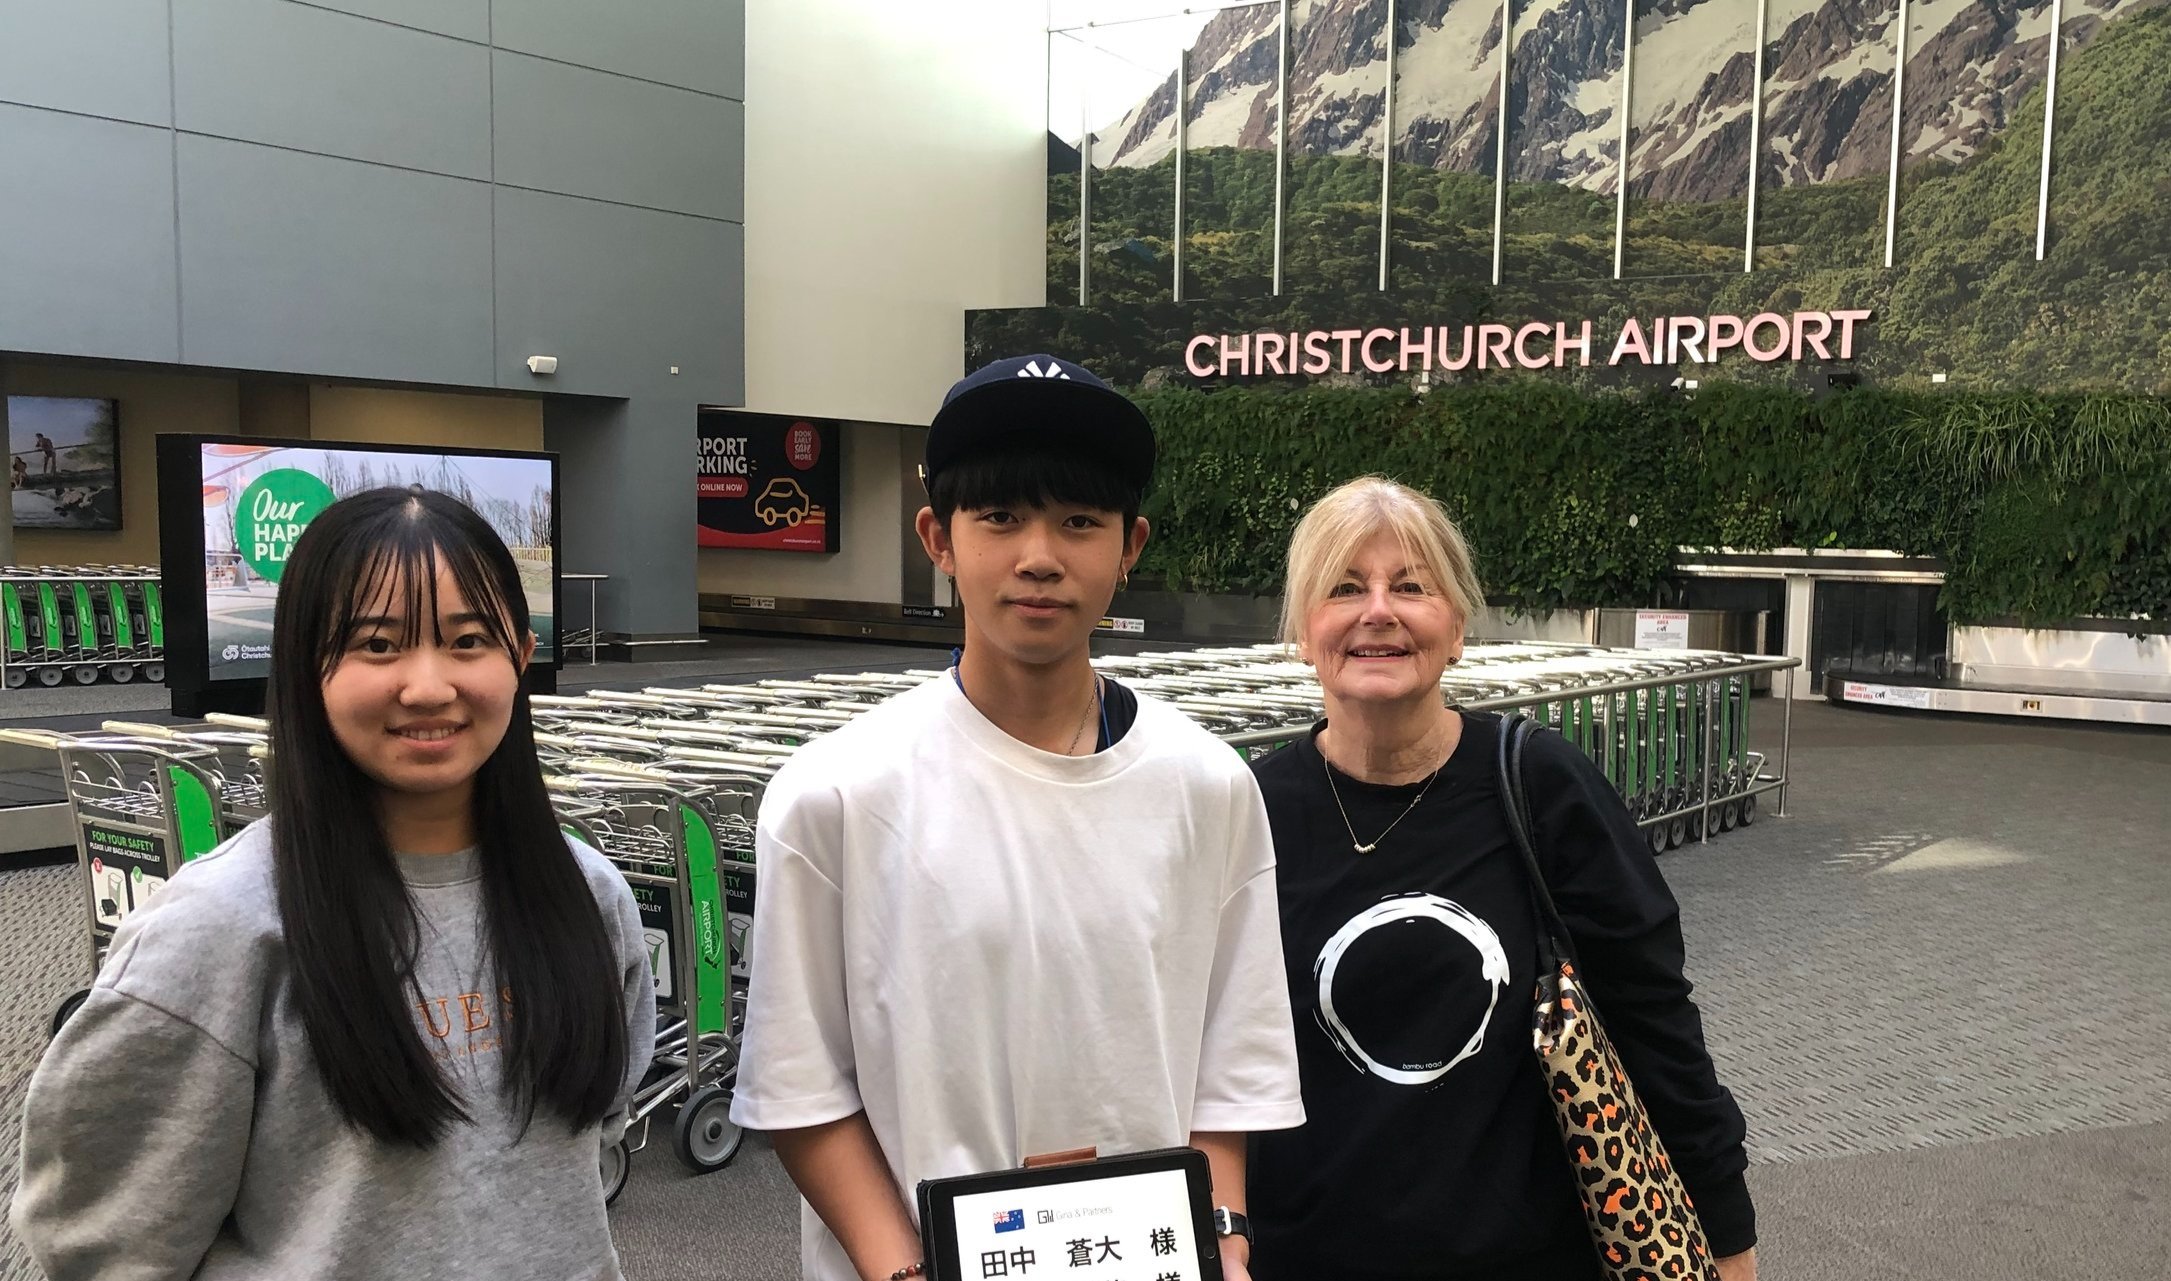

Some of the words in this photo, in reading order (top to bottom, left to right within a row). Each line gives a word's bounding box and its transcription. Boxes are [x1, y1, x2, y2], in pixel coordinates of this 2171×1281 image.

[1184, 320, 1592, 377] CHRISTCHURCH
[1607, 309, 1872, 365] AIRPORT
[700, 483, 725, 491] ONLINE
[726, 483, 743, 491] NOW
[253, 488, 305, 522] Our
[90, 841, 104, 851] PLEASE
[113, 846, 124, 855] BAGS
[124, 849, 141, 859] ACROSS
[141, 852, 160, 863] TROLLEY
[92, 830, 106, 843] FOR
[107, 833, 127, 847] YOUR
[128, 837, 154, 852] SAFETY
[654, 864, 673, 877] FOR
[701, 900, 713, 955] AIRPORT
[1425, 1060, 1443, 1069] road
[1074, 1208, 1081, 1218] &
[1082, 1206, 1113, 1217] Partners
[981, 1246, 1036, 1279] 田中
[1066, 1235, 1123, 1268] 蒼大
[1150, 1227, 1178, 1256] 様
